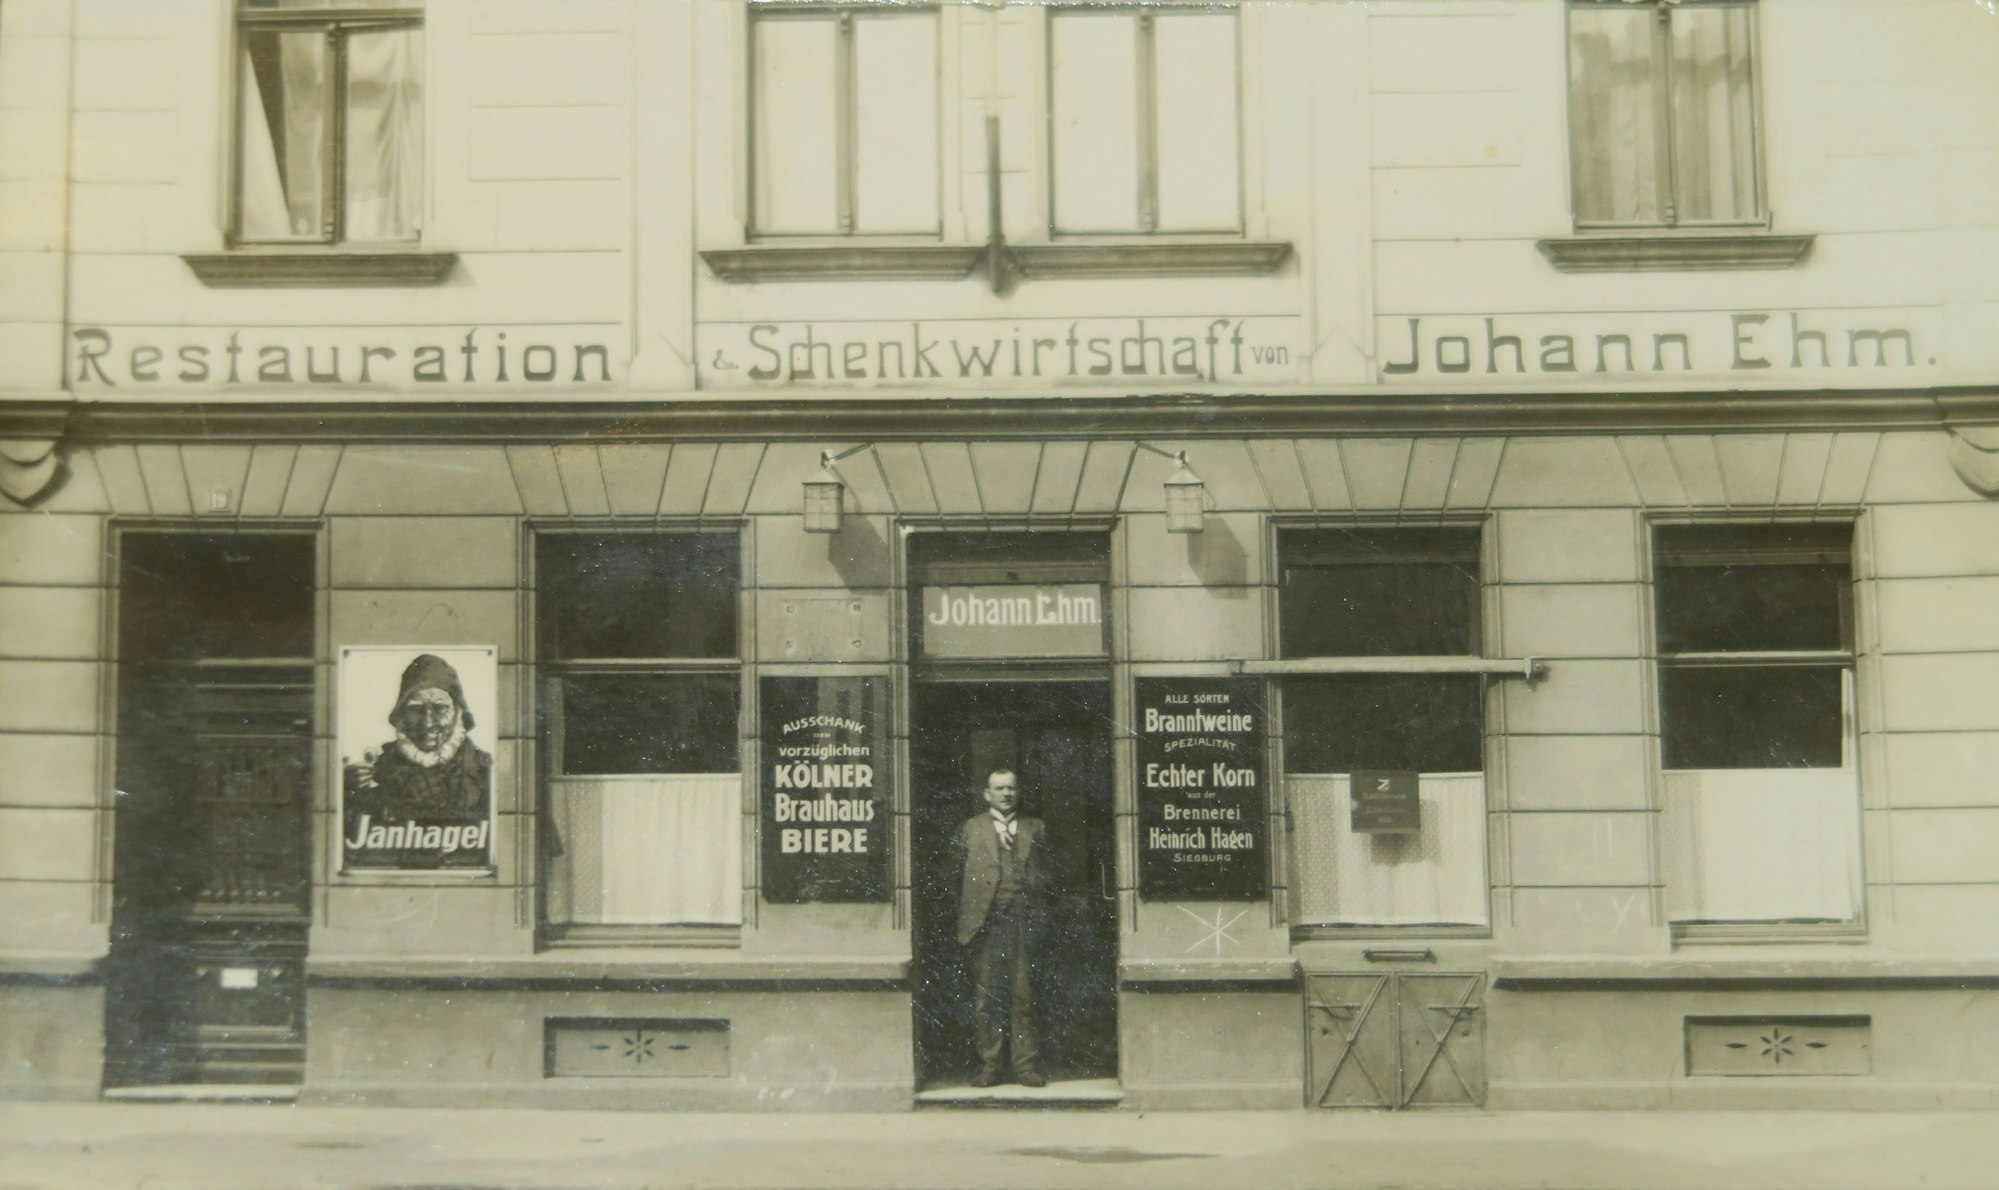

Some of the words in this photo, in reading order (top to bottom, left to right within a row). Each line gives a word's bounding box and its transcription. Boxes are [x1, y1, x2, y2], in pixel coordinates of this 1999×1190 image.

[73, 328, 613, 387] Restauration
[747, 319, 1246, 382] Schenkwirtschaft
[1252, 345, 1289, 365] von
[1382, 317, 1692, 375] Johann
[1730, 312, 1938, 369] Ehm.
[928, 591, 1032, 626] Johann
[1165, 694, 1189, 704] ALLE
[1194, 694, 1230, 704] SORTEN
[783, 715, 866, 735] AUSSCHANK
[1145, 708, 1253, 733] Branntweine
[779, 743, 870, 760] vorzüglichen
[1164, 738, 1237, 752] SPEZIALITÄT
[775, 760, 873, 788] KÖLNER
[1146, 762, 1206, 788] Echter
[1213, 762, 1256, 788] Korn
[1204, 790, 1217, 798] der
[775, 792, 875, 822] Brauhaus
[1164, 803, 1241, 820] Brennerei
[345, 814, 489, 853] Janhagel
[782, 828, 868, 853] BIERE
[1150, 827, 1206, 849] Heinrich
[1211, 827, 1253, 849] Hagen
[1173, 853, 1231, 862] SIEGBURG
